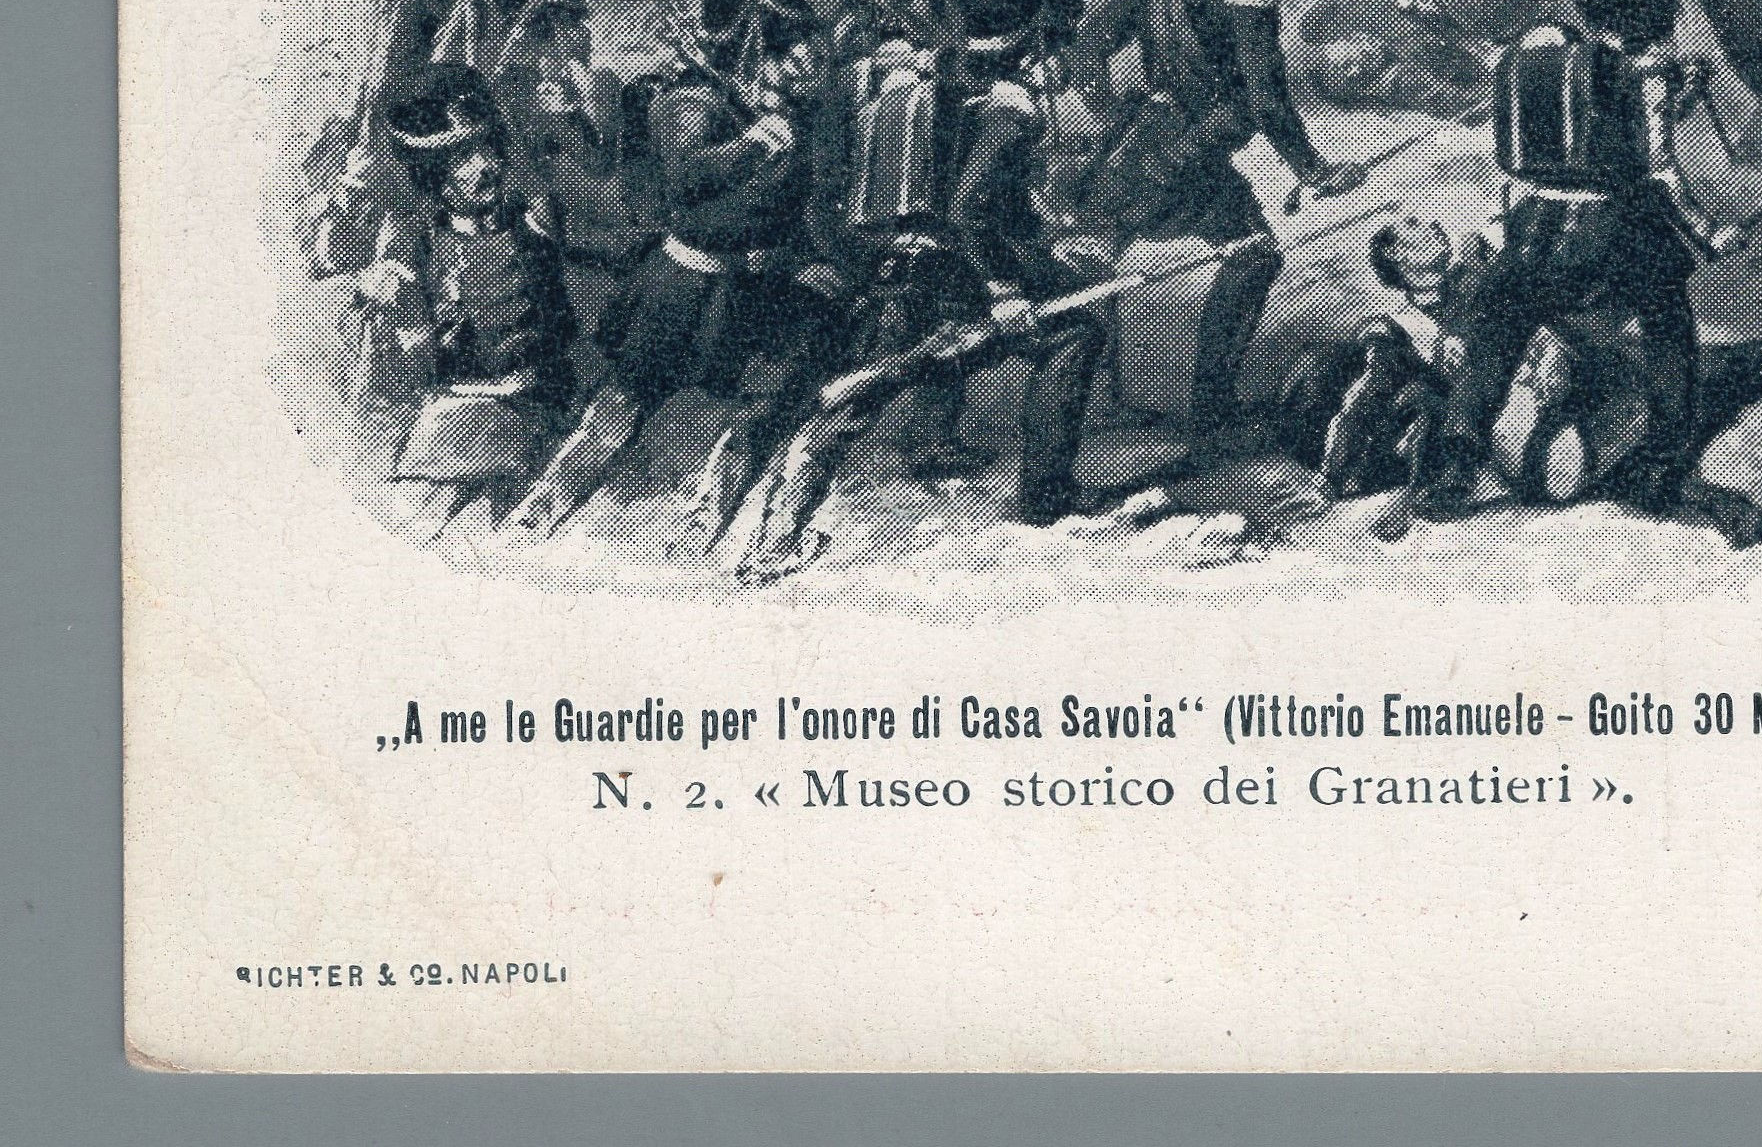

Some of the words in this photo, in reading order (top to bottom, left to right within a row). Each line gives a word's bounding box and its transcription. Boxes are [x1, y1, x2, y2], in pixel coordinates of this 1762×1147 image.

[440, 710, 487, 743] me
[505, 699, 535, 742] le
[554, 698, 684, 742] Guardie
[701, 708, 758, 751] per
[912, 695, 941, 739] di
[961, 695, 1043, 740] Casa
[1224, 693, 1364, 744] (Vittorio
[1383, 692, 1544, 737] Emanuele
[1589, 691, 1673, 736] Goito
[1693, 692, 1734, 735] 30
[592, 771, 652, 810] N.
[684, 782, 724, 810] 2.
[802, 769, 971, 808] Museo
[1003, 767, 1175, 807] storico
[1203, 765, 1278, 804] dei
[1309, 763, 1572, 806] Granatieri
[236, 965, 363, 988] RICHTER
[377, 962, 397, 988] &
[461, 963, 567, 985] NAPOLI
